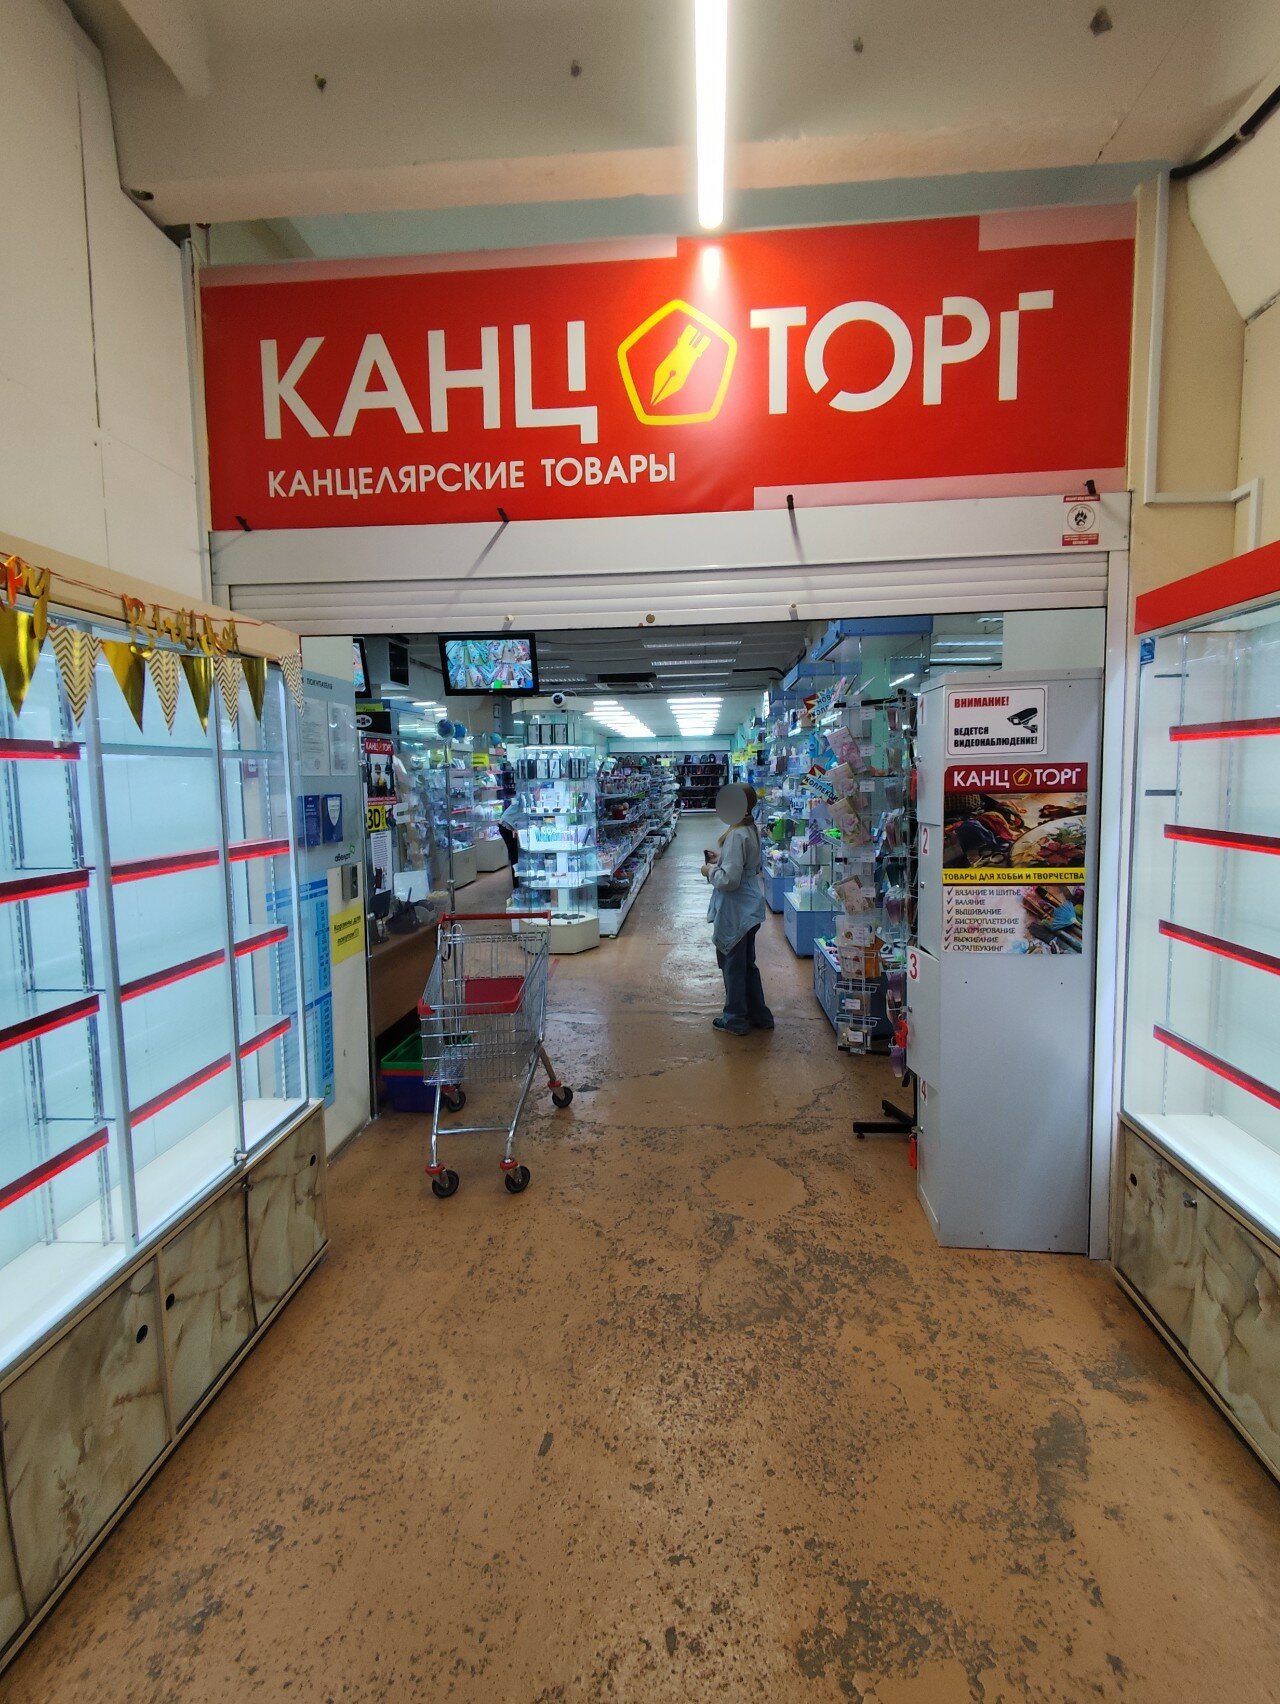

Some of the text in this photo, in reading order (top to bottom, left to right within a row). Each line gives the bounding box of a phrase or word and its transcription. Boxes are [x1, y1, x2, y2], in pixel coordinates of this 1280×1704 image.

[259, 289, 1054, 445] КАНЦ ТОРГ
[268, 452, 676, 500] КАНЦЕЛЯРСКИЕ ТОВАРЫ
[919, 697, 925, 725] 1
[954, 696, 1010, 708] ВНИМАНИЕ!
[953, 736, 1038, 748] ВИДЕОНАБЛЮДЕНИЕ!
[954, 727, 989, 737] ВЕДЕТСЯ
[953, 767, 1082, 789] КАНЦ ТОРГ
[922, 827, 929, 854] 2
[978, 873, 994, 881] ДЛЯ
[1033, 872, 1084, 880] ТВОРЧЕСТВА
[909, 953, 918, 980] 3
